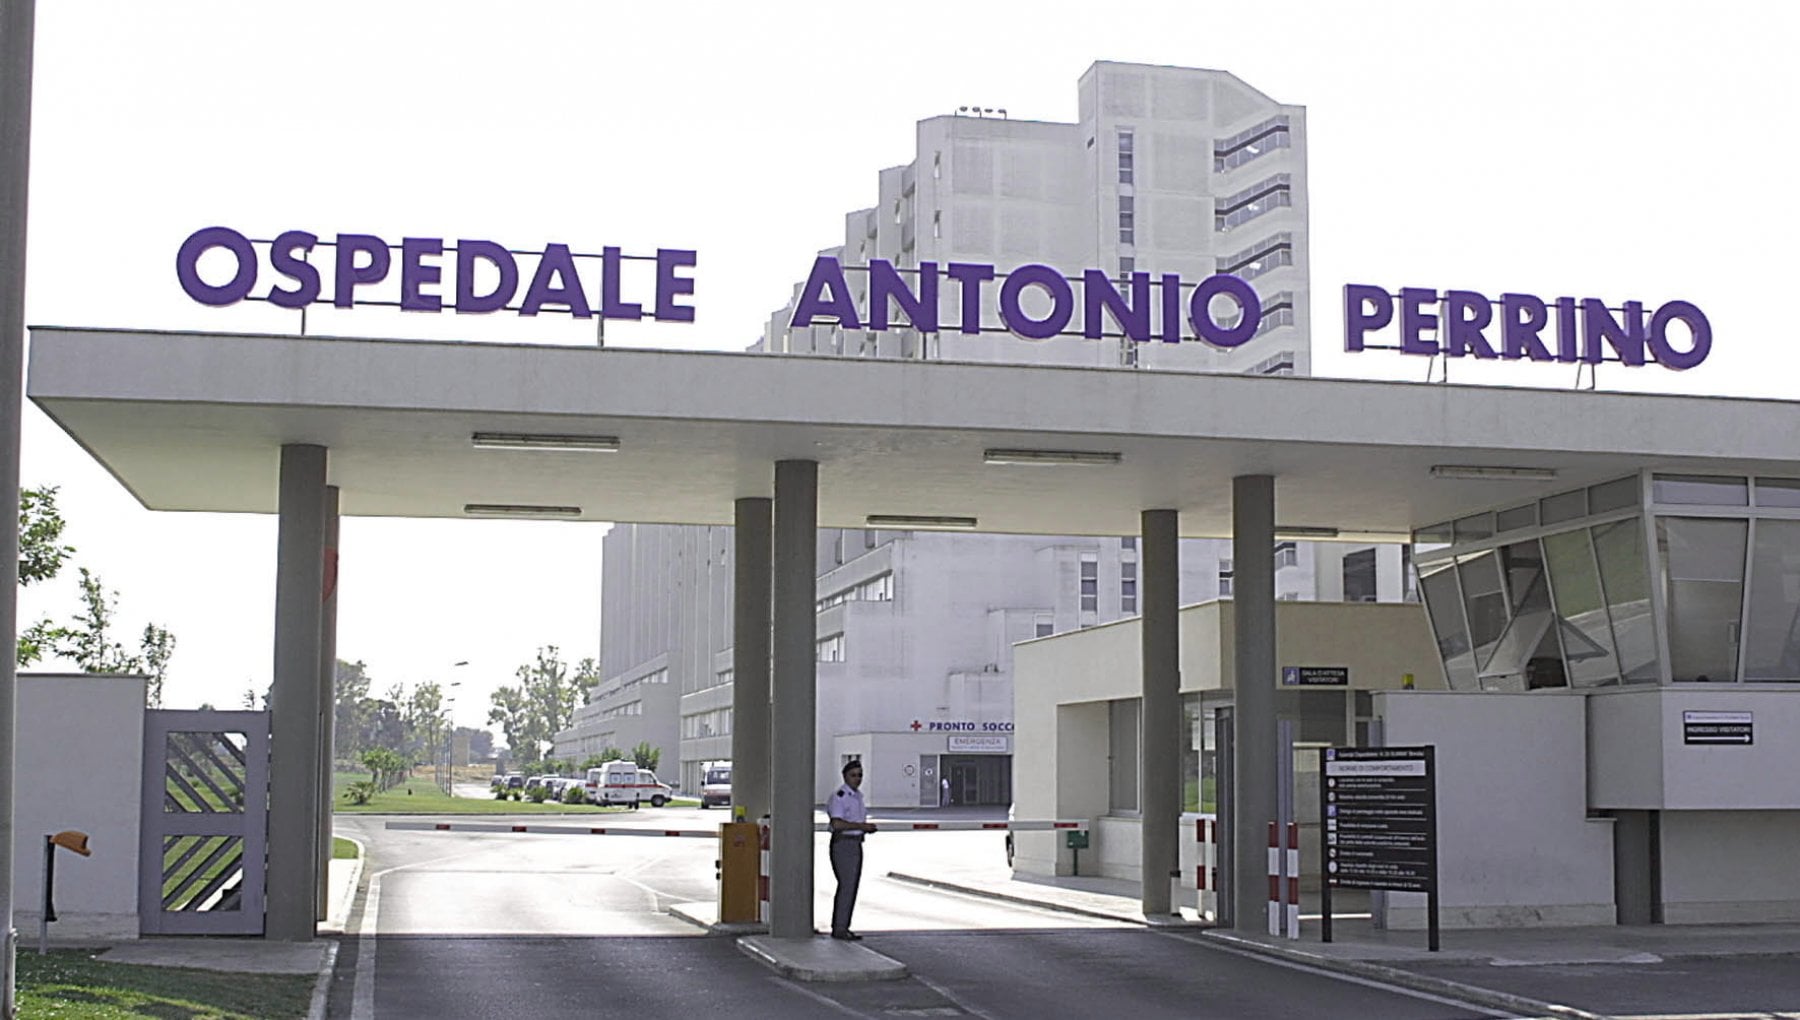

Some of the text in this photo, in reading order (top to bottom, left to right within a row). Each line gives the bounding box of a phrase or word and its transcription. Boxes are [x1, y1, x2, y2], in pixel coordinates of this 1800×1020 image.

[176, 226, 1712, 370] OSPEDALE ANTONIO PERRINO
[929, 722, 975, 731] PRONTO
